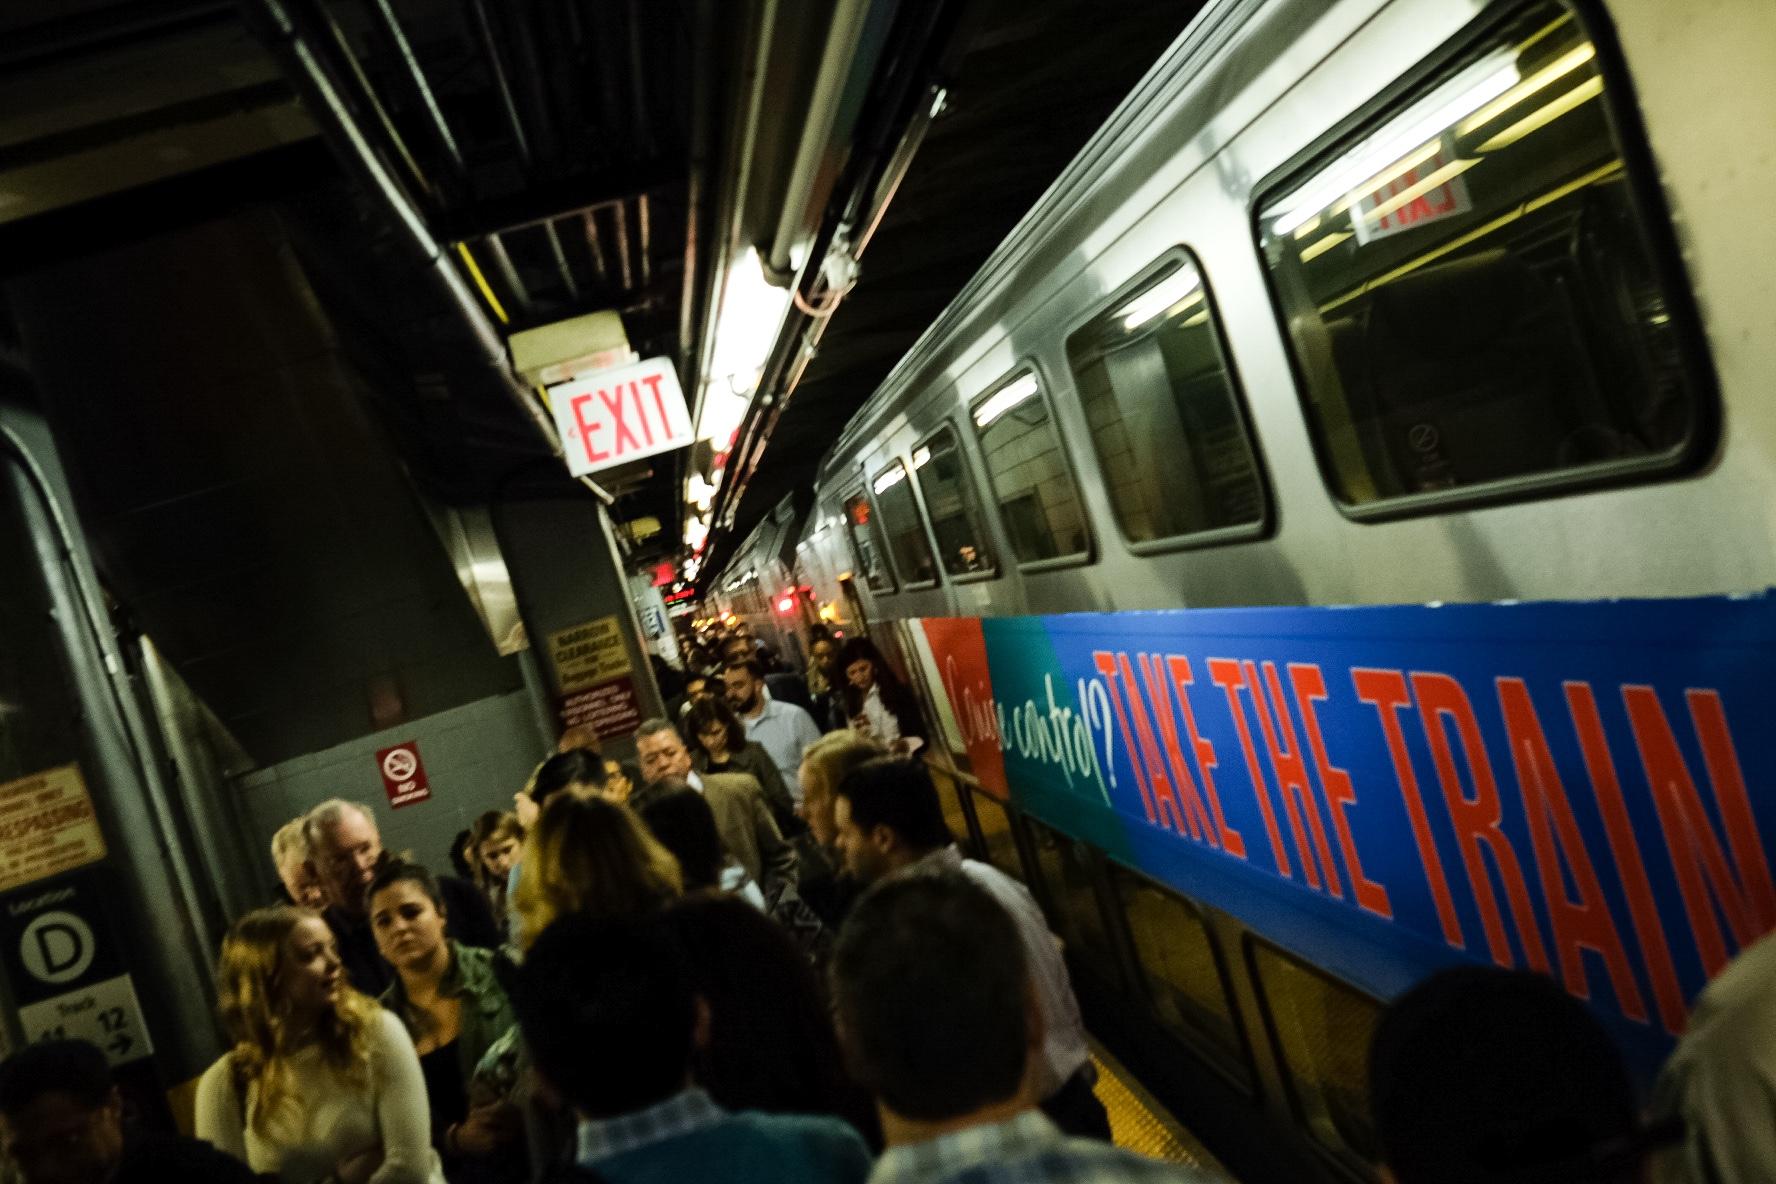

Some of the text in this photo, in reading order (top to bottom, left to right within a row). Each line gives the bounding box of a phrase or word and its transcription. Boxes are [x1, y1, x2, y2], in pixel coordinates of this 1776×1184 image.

[569, 373, 674, 463] EXIT
[1093, 650, 1776, 1036] TAKE THE TRAIN
[35, 923, 83, 975] D
[97, 1005, 126, 1033] 12
